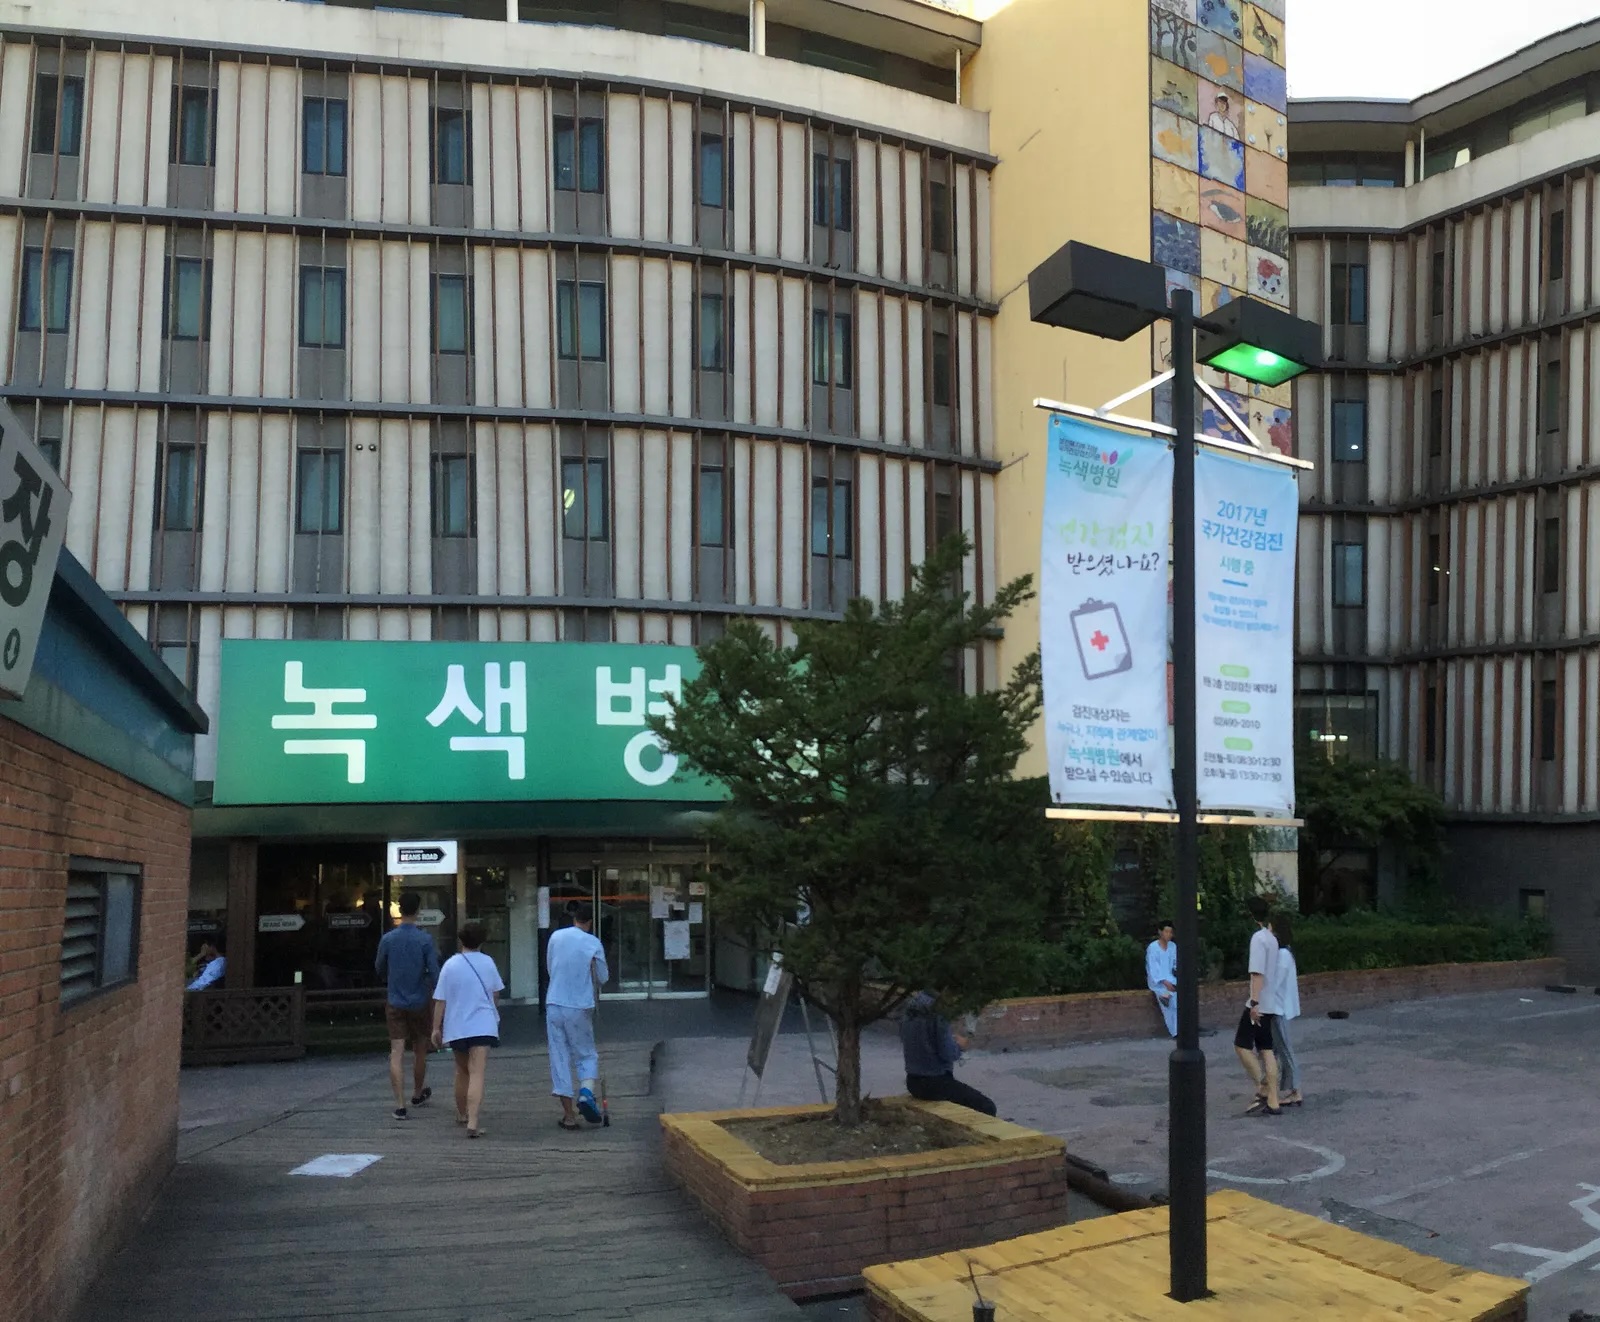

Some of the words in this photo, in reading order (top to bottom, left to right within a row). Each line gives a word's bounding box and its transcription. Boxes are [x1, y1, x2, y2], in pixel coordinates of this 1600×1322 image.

[1058, 456, 1121, 489] 녹색병원
[1217, 500, 1268, 527] 2017년
[1201, 518, 1284, 552] 국가건강검진
[1067, 552, 1160, 577] 받으셨나요?
[271, 660, 820, 786] 녹색병
